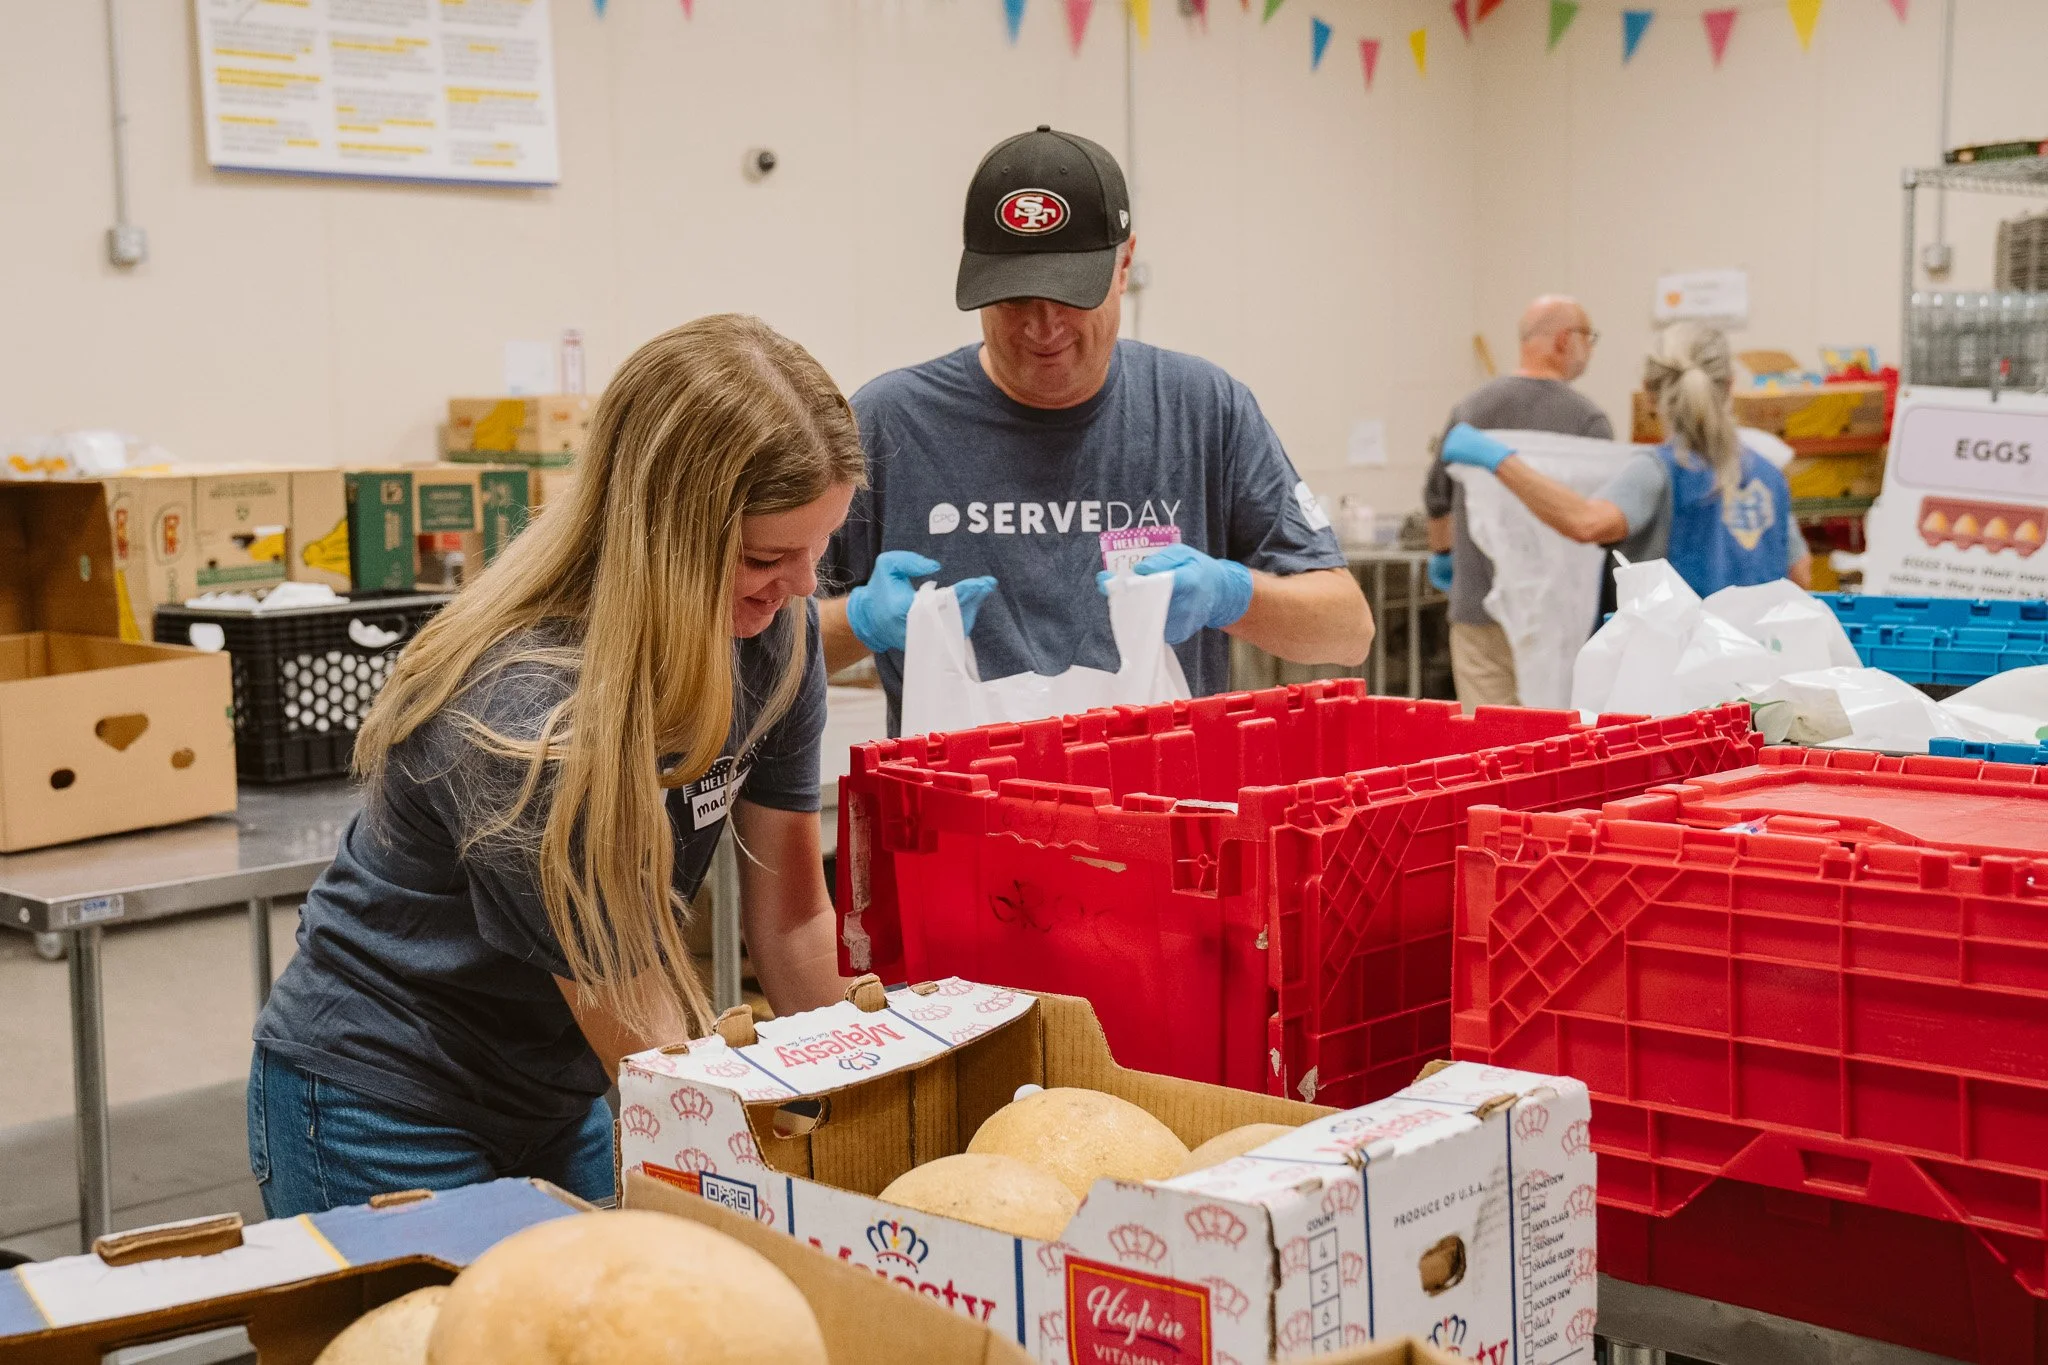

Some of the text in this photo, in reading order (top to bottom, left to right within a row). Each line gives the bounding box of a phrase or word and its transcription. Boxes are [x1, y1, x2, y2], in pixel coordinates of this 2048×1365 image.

[1955, 438, 2033, 465] EGGS
[1112, 536, 1150, 551] HELLO
[774, 1023, 906, 1068] Majesty
[1530, 1173, 1565, 1193] HONEYDEW
[1393, 1181, 1487, 1228] PRODUCE OF U.S.A.
[1306, 1212, 1335, 1232] COUNT
[1319, 1240, 1328, 1255] 4
[1532, 1254, 1557, 1273] ORANGE
[1321, 1273, 1330, 1293] 5
[1532, 1286, 1571, 1311] GOLDEN DEW
[1087, 1285, 1186, 1345] High in
[1321, 1308, 1330, 1326] 6
